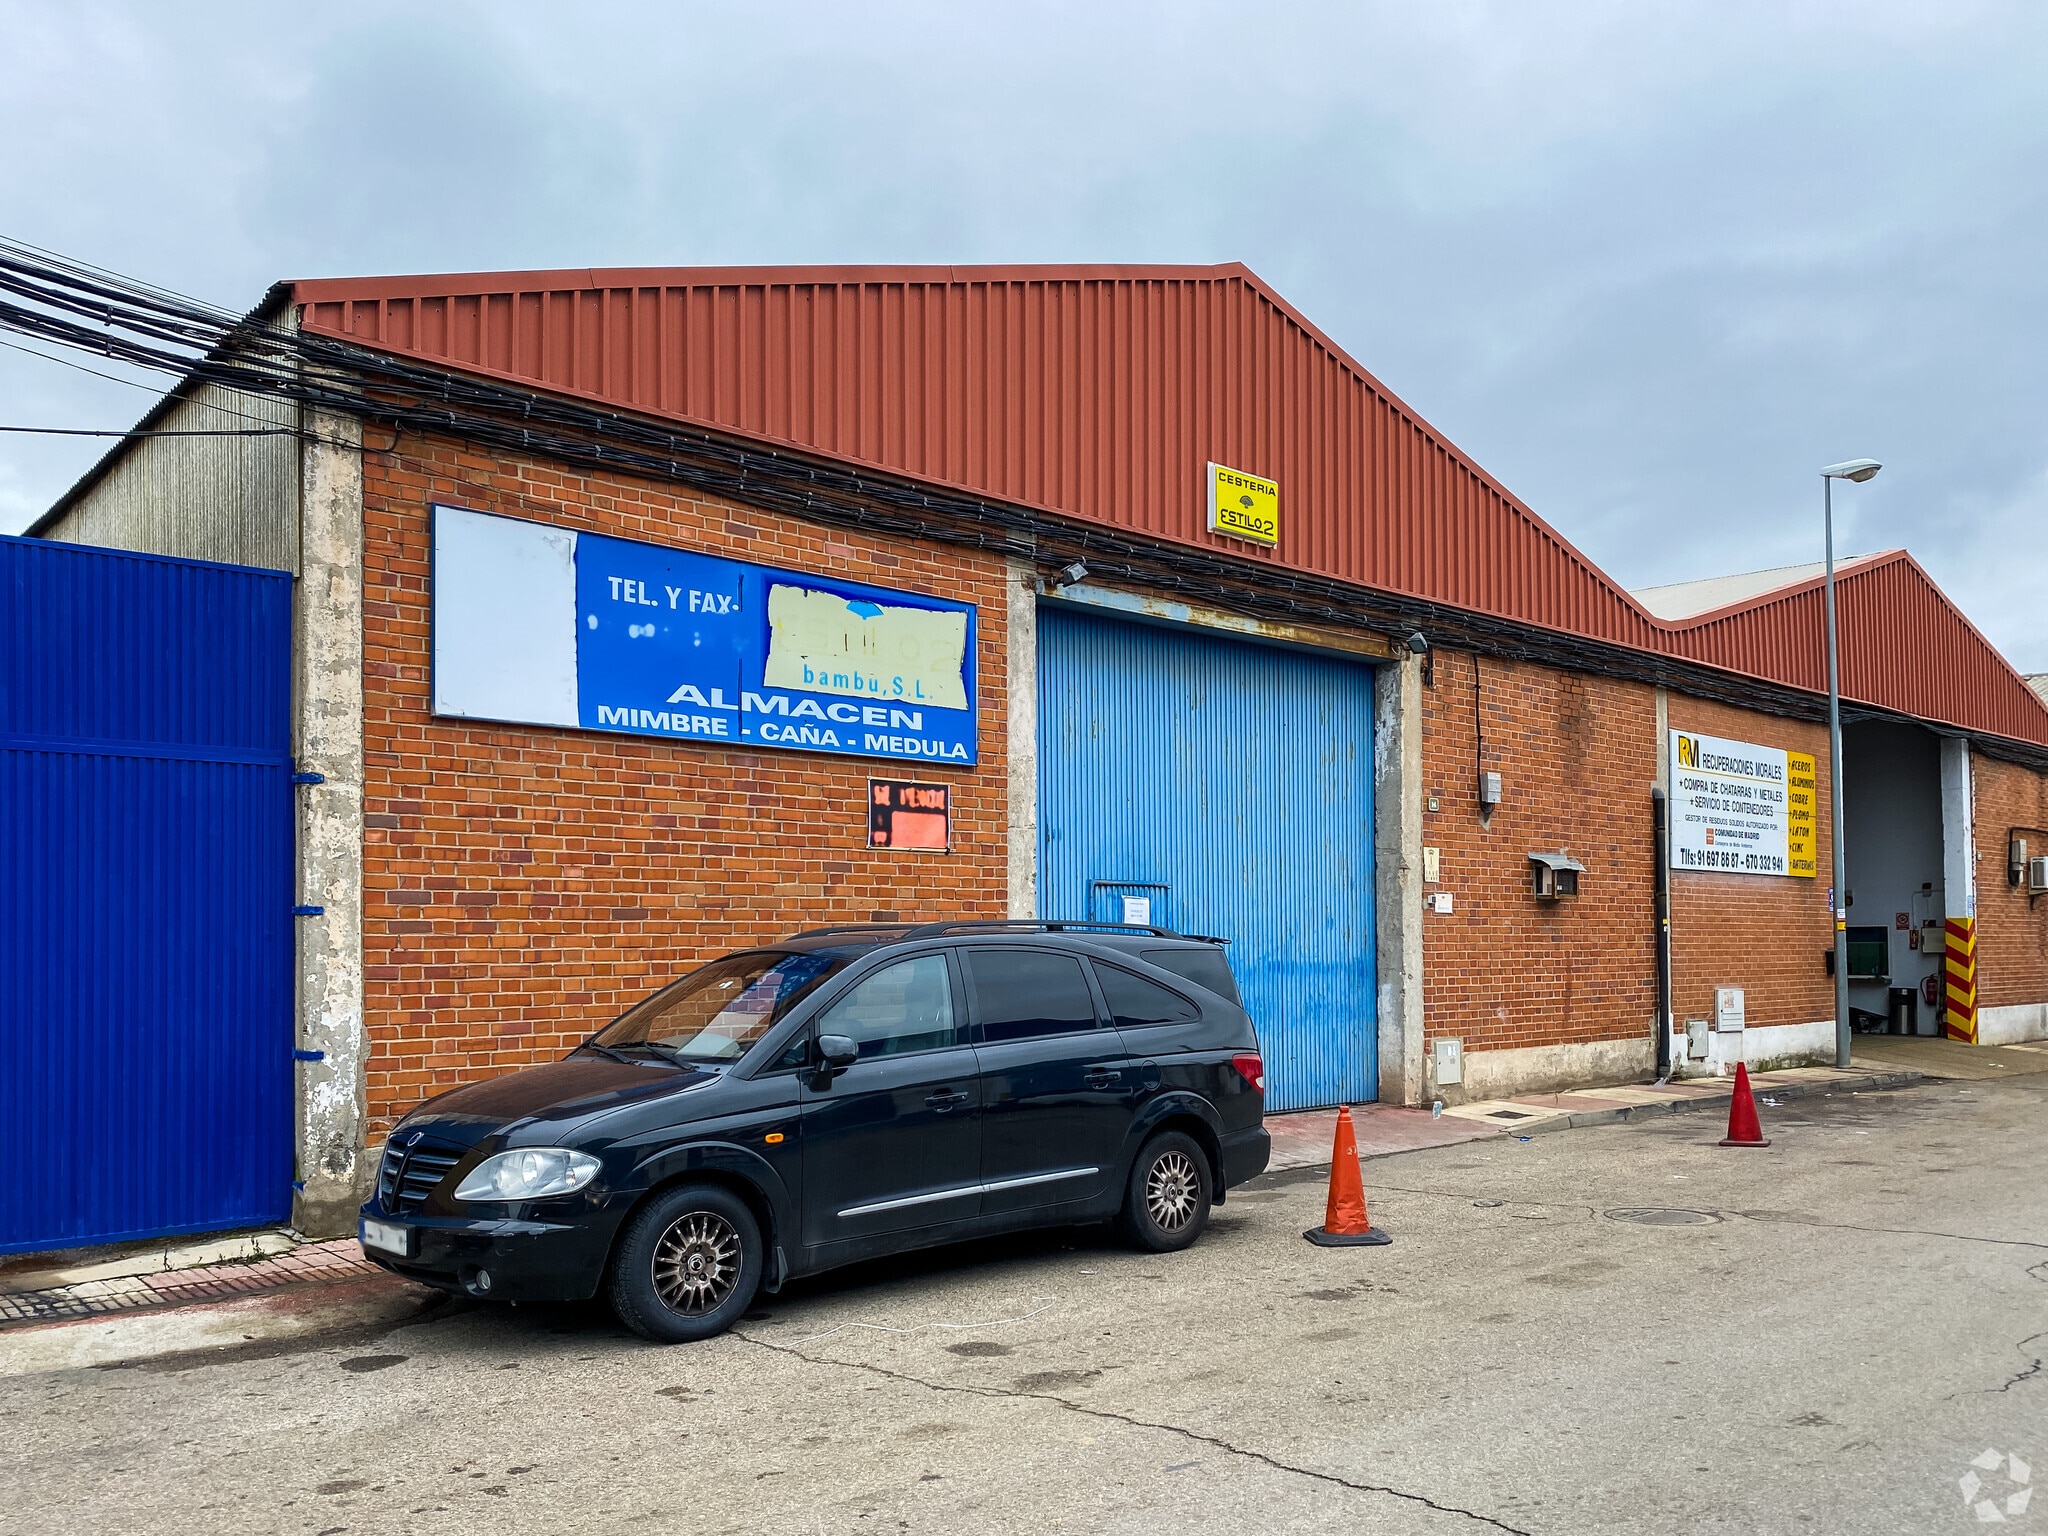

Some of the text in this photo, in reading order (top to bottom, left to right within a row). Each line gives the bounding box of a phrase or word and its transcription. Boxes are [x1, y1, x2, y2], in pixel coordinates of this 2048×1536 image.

[1218, 472, 1276, 497] CESTERIA
[607, 575, 659, 607] TEL.
[664, 585, 684, 611] Y
[665, 683, 924, 731] ALMACEN
[597, 704, 730, 737] MIMBRE
[759, 720, 840, 748] CAÑA
[863, 733, 969, 761] MEDULA
[1702, 752, 1782, 781] RECUPERACIONES MORALES
[1710, 782, 1718, 794] DE
[1719, 783, 1752, 799] CHATARRAS
[1754, 787, 1758, 799] Y
[1759, 789, 1783, 803] METALES
[1791, 793, 1809, 806] COBRE
[1694, 795, 1774, 817] SERVICIO DE CONTENEDORES
[1714, 828, 1760, 840] COMUNIDAD DE MADRID
[1697, 849, 1705, 866] 91
[1706, 850, 1720, 867] 697
[1721, 851, 1730, 867] 86
[1731, 853, 1739, 869] 87
[1745, 853, 1758, 870] 670
[1759, 855, 1771, 870] 332
[1771, 856, 1783, 872] 941
